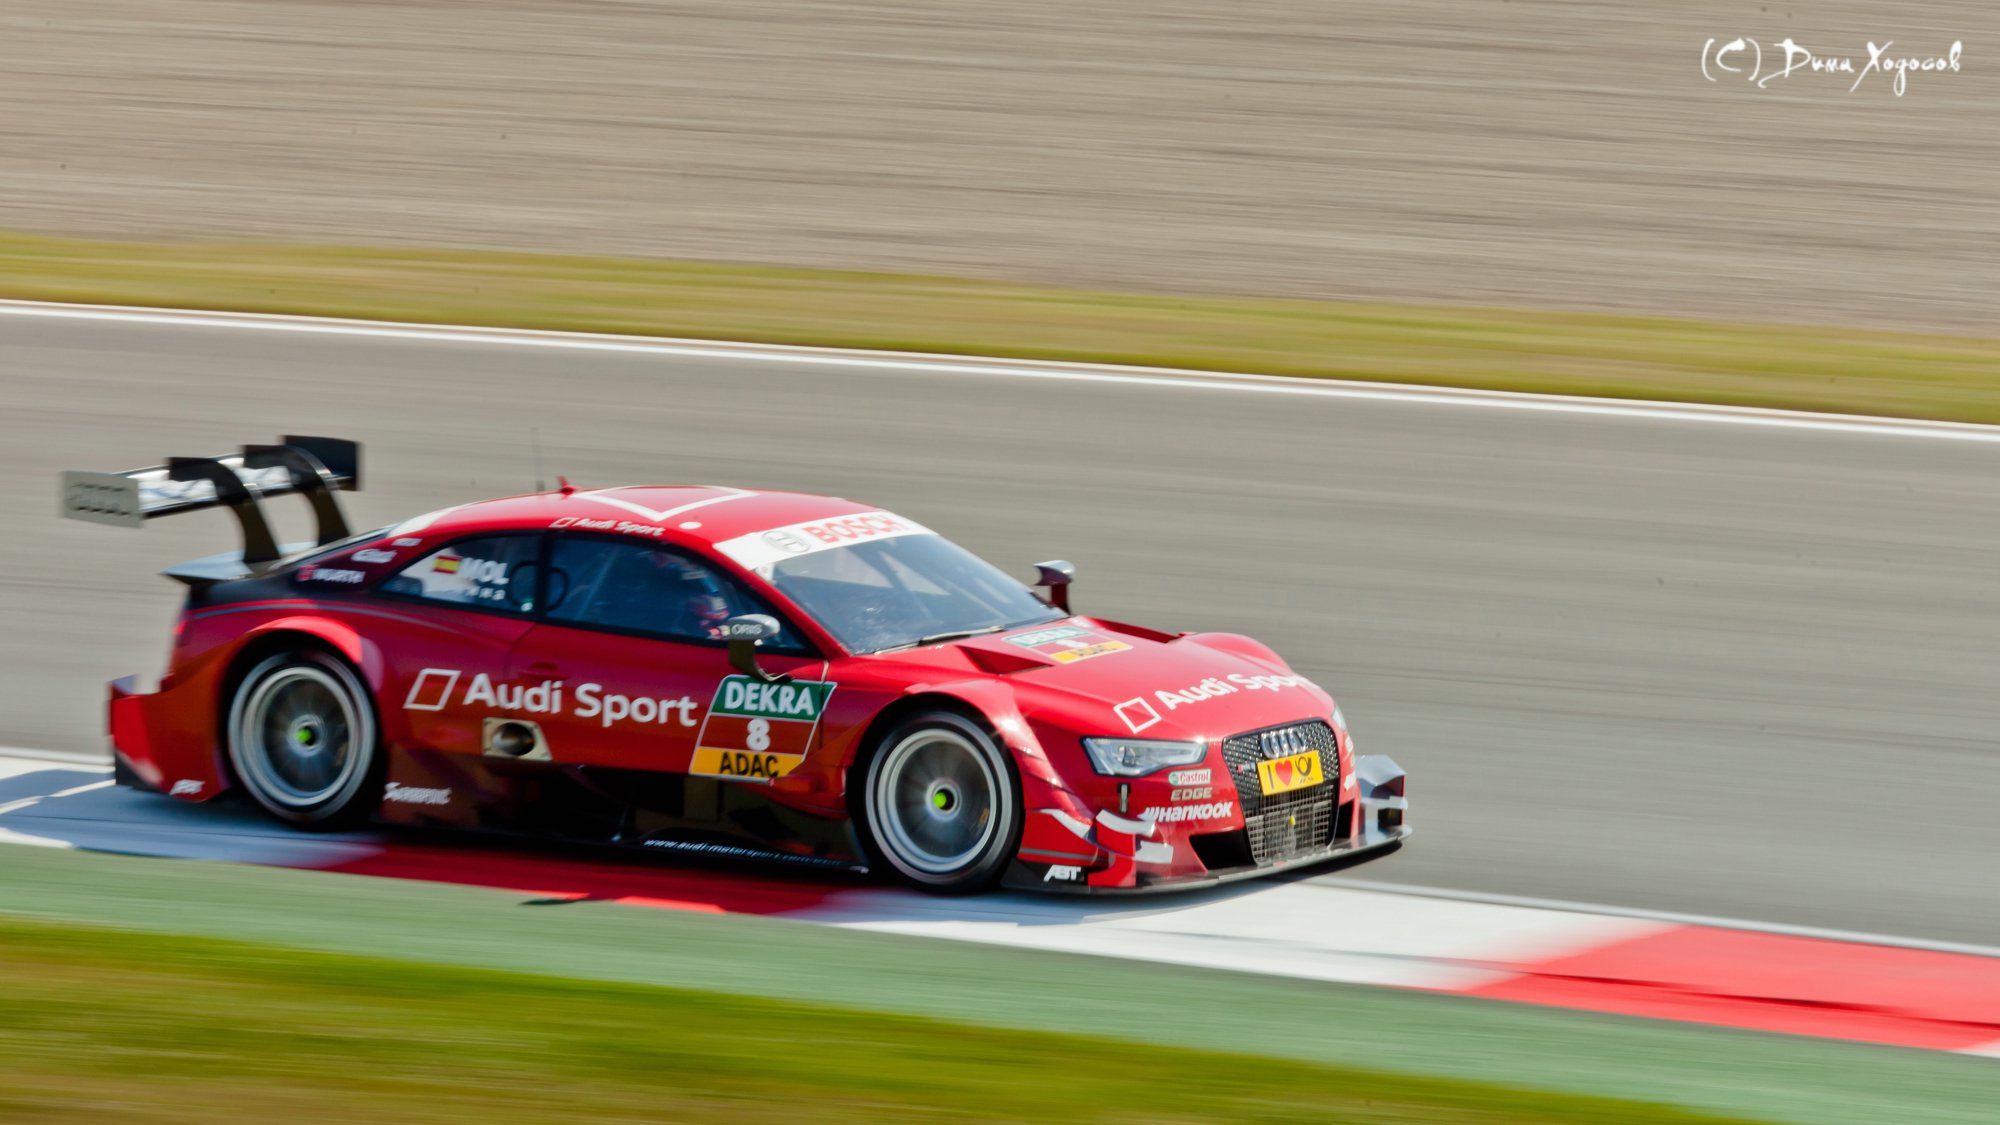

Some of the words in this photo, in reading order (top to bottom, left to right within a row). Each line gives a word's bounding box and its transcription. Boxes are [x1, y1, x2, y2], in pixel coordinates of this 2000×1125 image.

[572, 517, 618, 529] Audi
[614, 521, 666, 537] Sport
[802, 514, 911, 544] BOSCH
[462, 673, 563, 714] Audi
[574, 682, 698, 728] Sport
[723, 681, 815, 716] DEKRA
[1154, 677, 1239, 711] Audi
[745, 718, 771, 752] 8
[718, 751, 780, 778] ADAC
[1180, 769, 1209, 784] Castrol
[1170, 786, 1213, 801] EDGE
[1043, 864, 1082, 882] ABT
